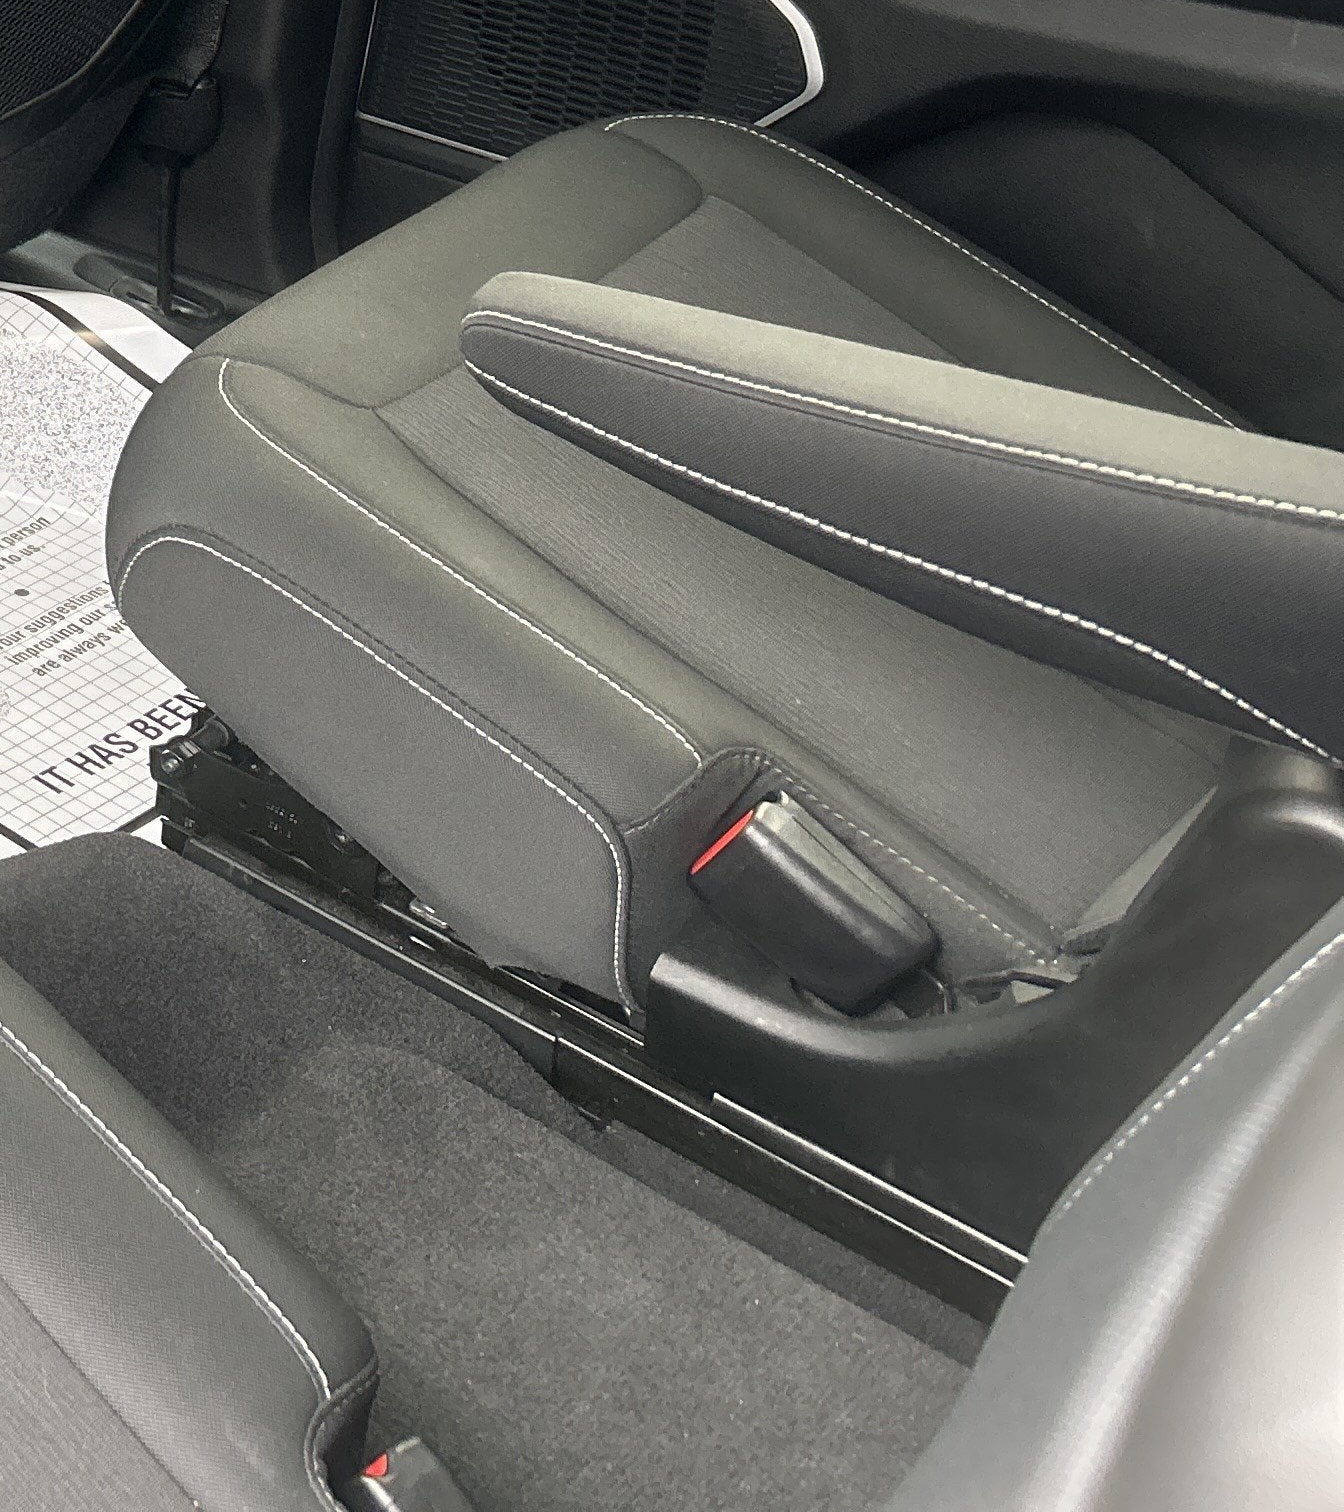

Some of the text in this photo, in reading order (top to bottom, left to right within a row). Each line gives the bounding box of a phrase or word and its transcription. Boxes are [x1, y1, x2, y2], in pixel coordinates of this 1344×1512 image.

[1, 553, 23, 565] to
[19, 544, 46, 557] us.
[2, 516, 52, 547] person
[24, 585, 109, 633] suggestions
[4, 622, 85, 665] improving
[78, 608, 107, 626] our
[32, 632, 112, 676] are always
[32, 765, 75, 794] IT
[64, 732, 139, 775] HAS
